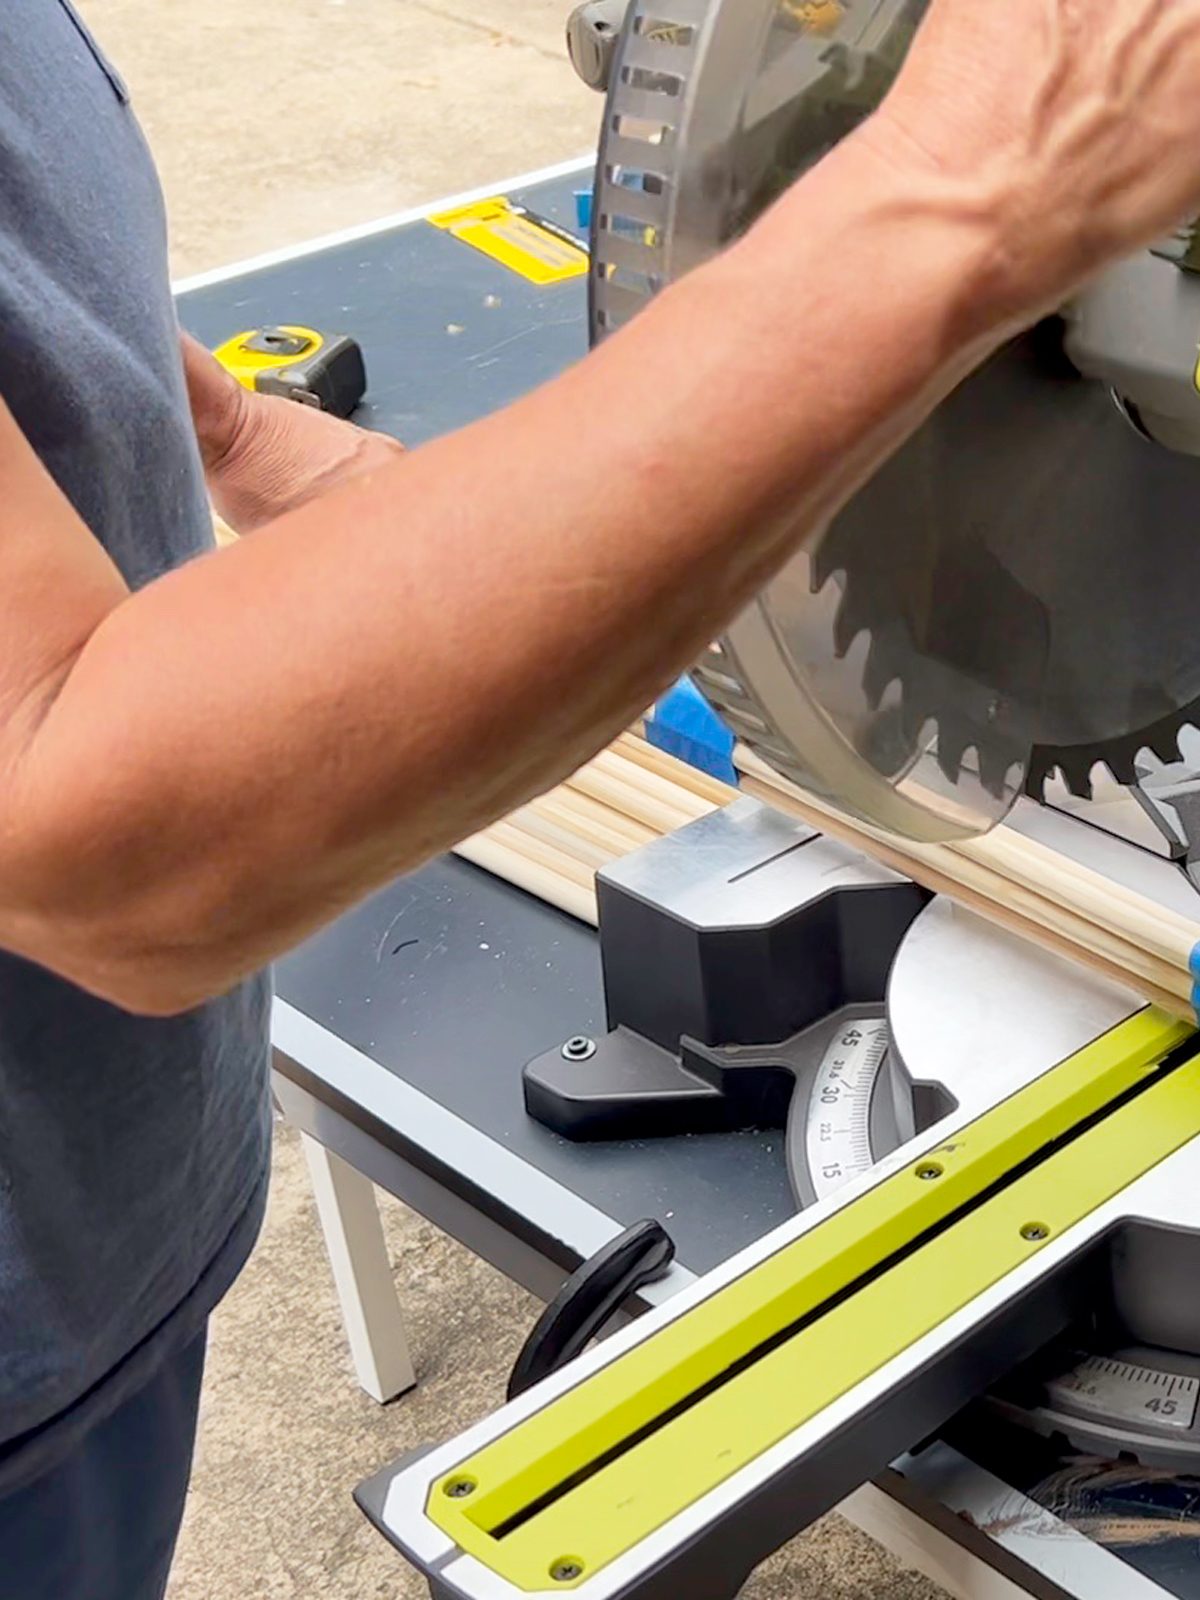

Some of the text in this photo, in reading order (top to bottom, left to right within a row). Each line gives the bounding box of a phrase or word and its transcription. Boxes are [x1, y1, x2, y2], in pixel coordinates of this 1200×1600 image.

[841, 1028, 863, 1048] 45
[820, 1086, 840, 1105] 30
[819, 1122, 832, 1143] 22.5
[822, 1162, 842, 1180] 15
[1144, 1397, 1179, 1416] 45
